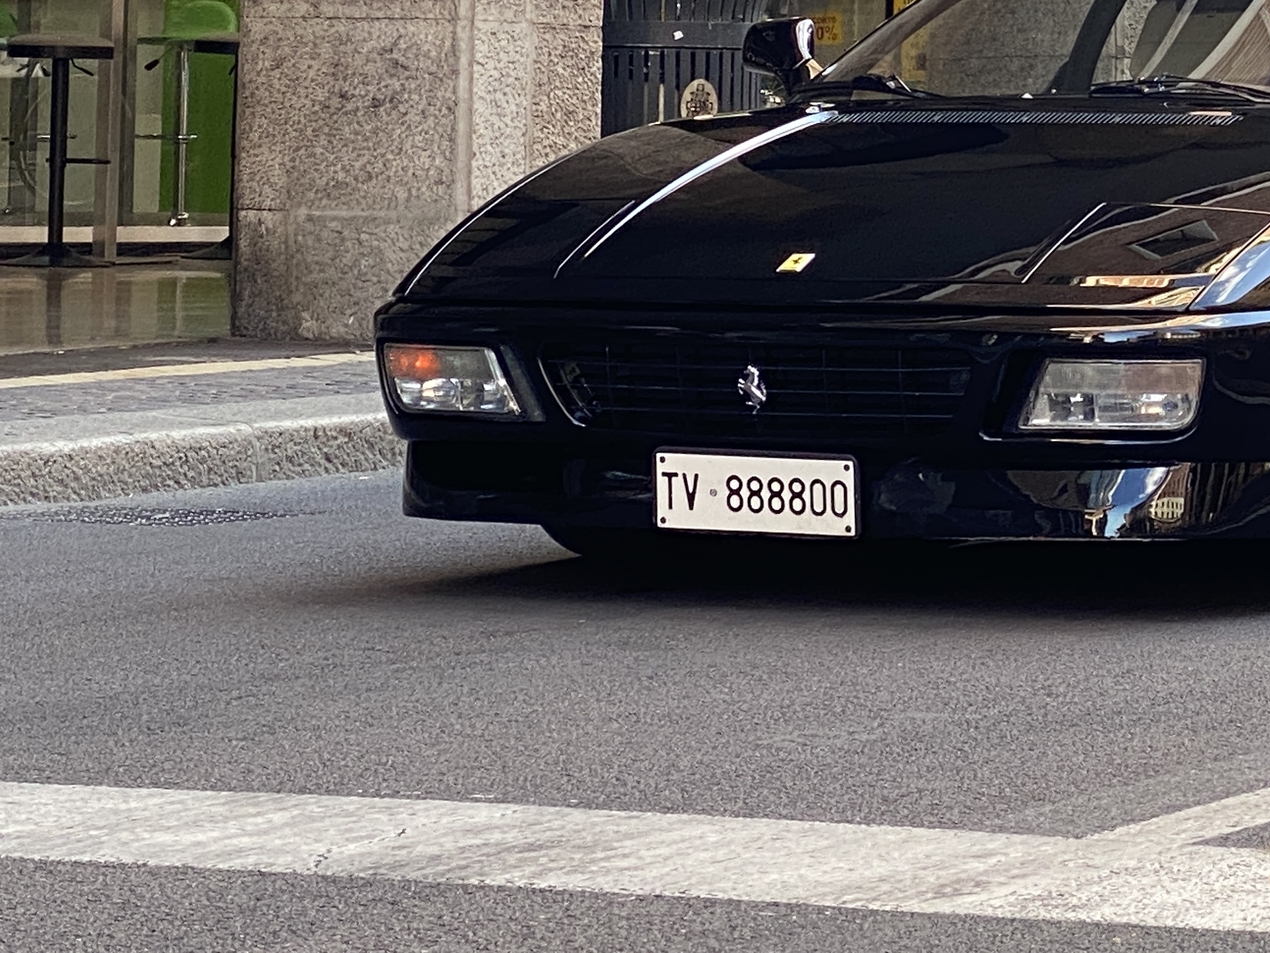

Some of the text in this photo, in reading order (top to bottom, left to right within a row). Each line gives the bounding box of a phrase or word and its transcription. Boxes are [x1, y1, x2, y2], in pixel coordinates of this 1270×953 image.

[816, 25, 838, 41] 0%
[661, 471, 848, 518] TV 888800
